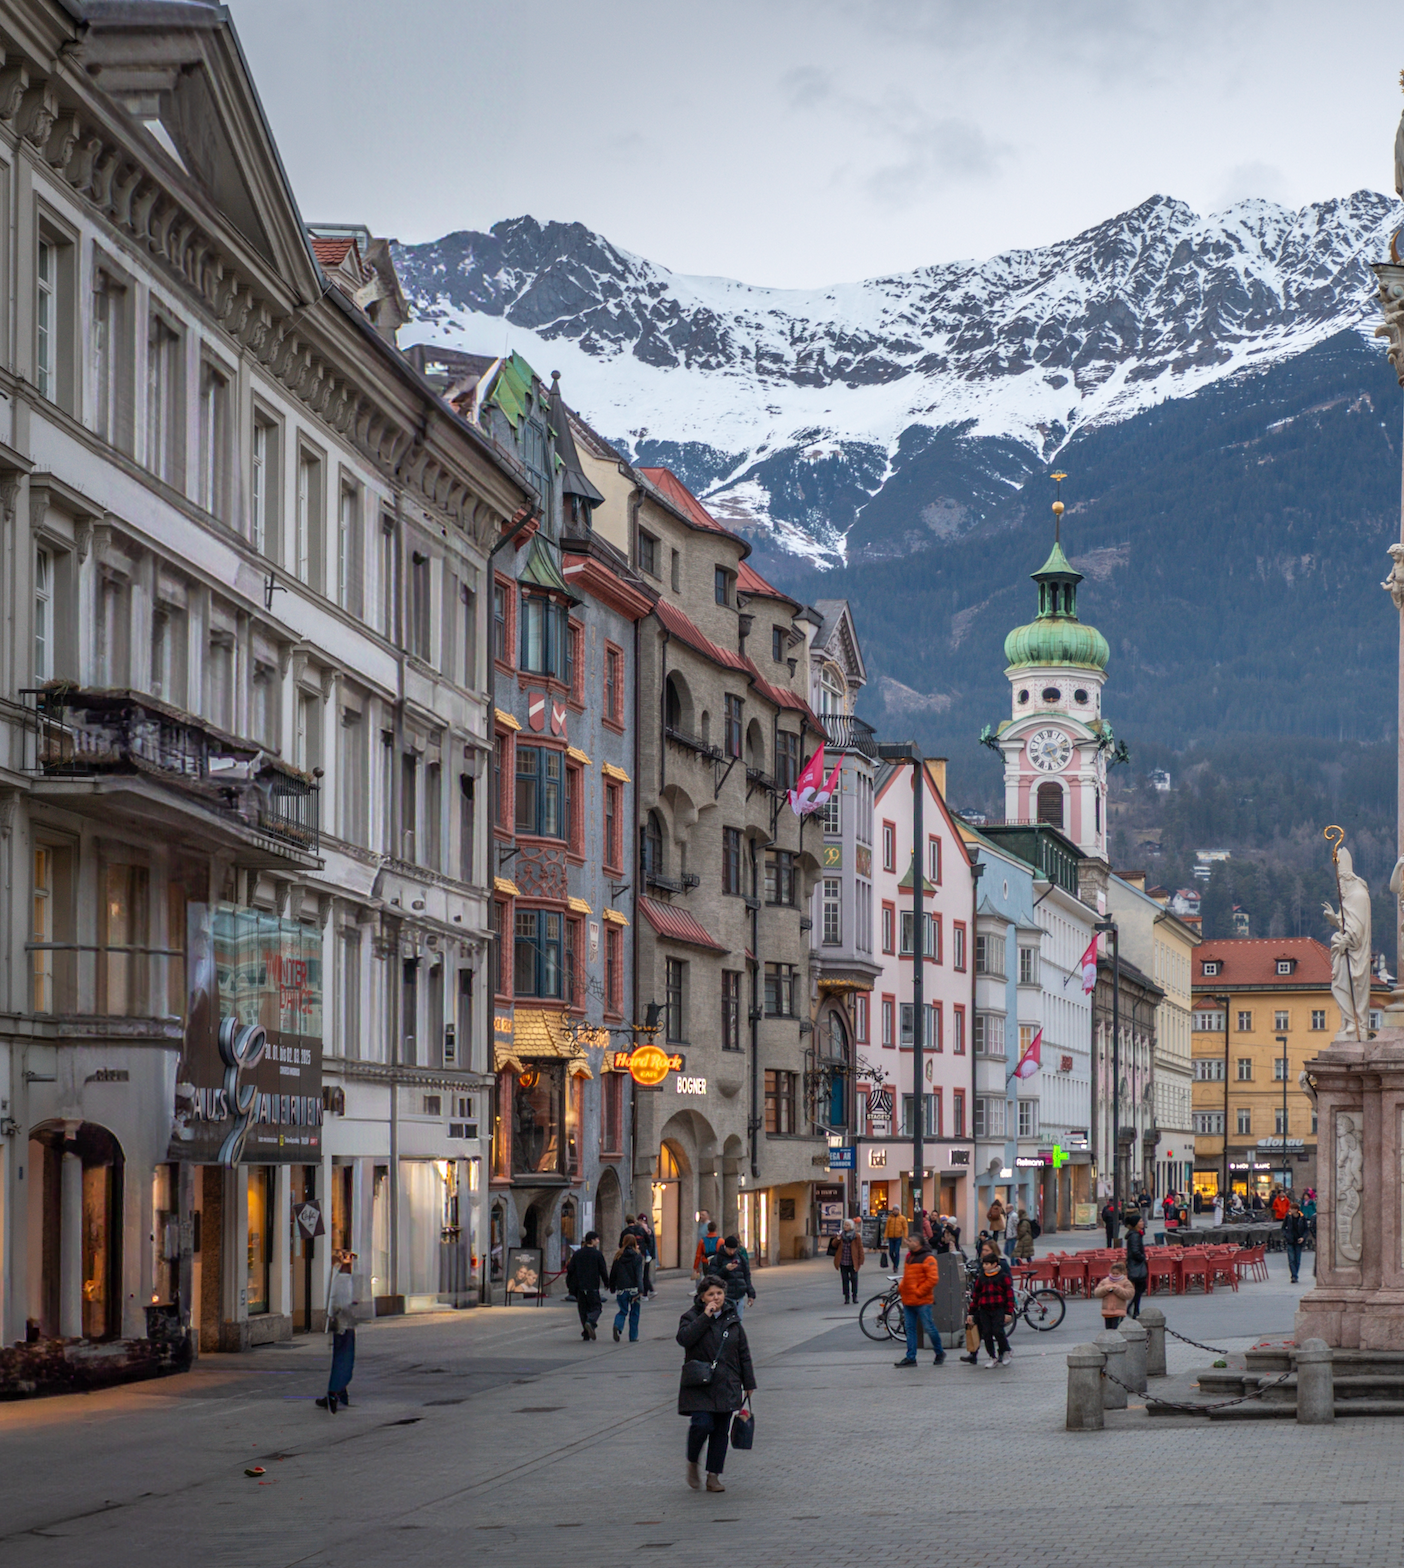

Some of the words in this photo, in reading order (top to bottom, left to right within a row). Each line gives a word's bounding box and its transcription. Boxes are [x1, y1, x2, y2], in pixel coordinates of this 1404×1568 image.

[266, 952, 307, 988] WINTER
[280, 983, 313, 1014] DANCE
[615, 1053, 650, 1067] Hard
[650, 1053, 682, 1071] Rock
[676, 1076, 707, 1095] BOGNER
